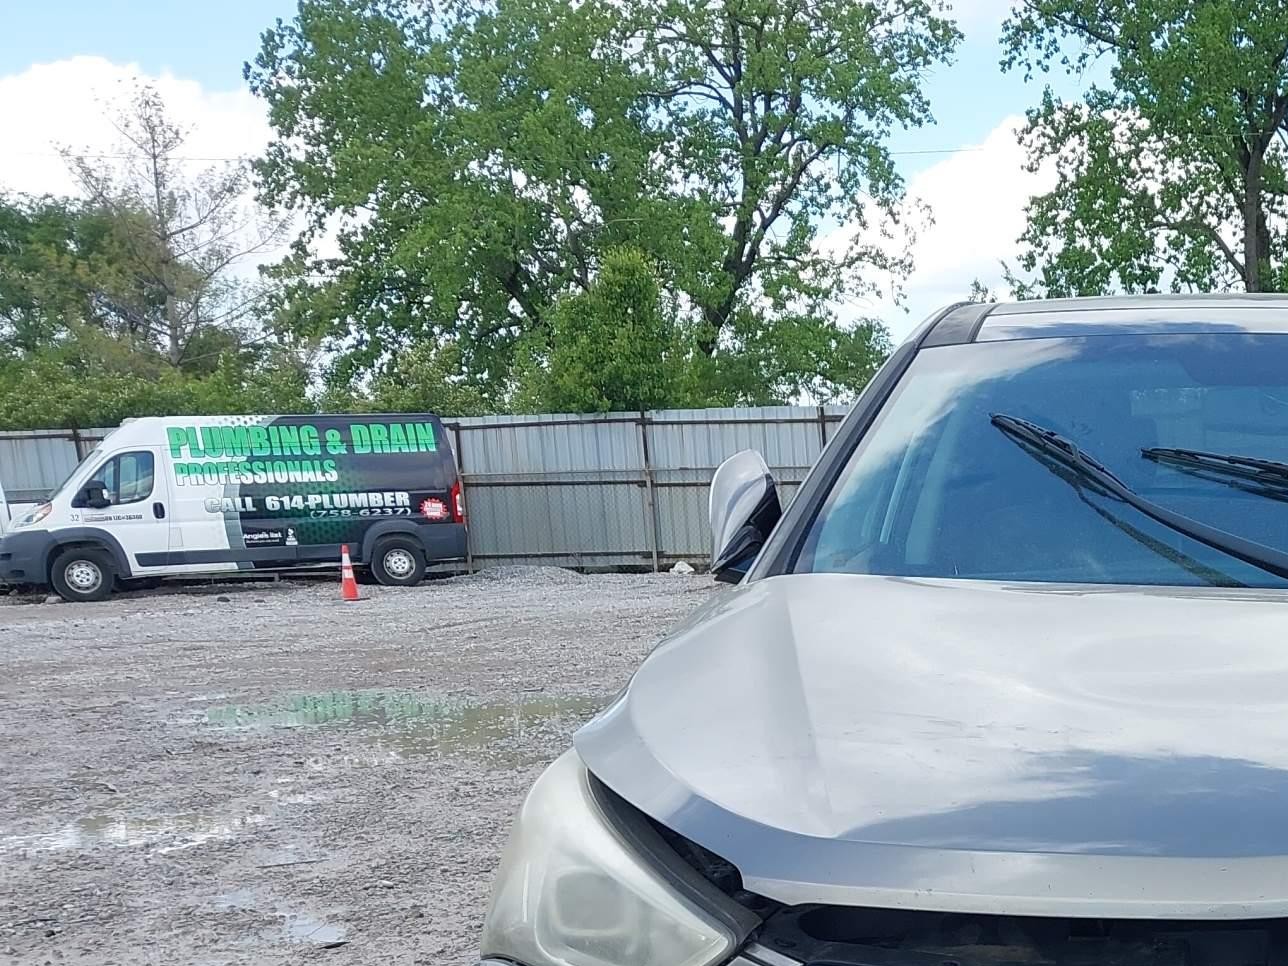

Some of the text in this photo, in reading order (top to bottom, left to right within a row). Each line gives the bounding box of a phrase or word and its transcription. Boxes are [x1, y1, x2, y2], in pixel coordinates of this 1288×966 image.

[166, 422, 437, 458] PLUMBING & DRAIN
[174, 459, 339, 486] PROFESSIONALS
[205, 496, 257, 514] CALL
[265, 491, 411, 512] 614-PLUMBER
[310, 508, 412, 519] (758-6237)
